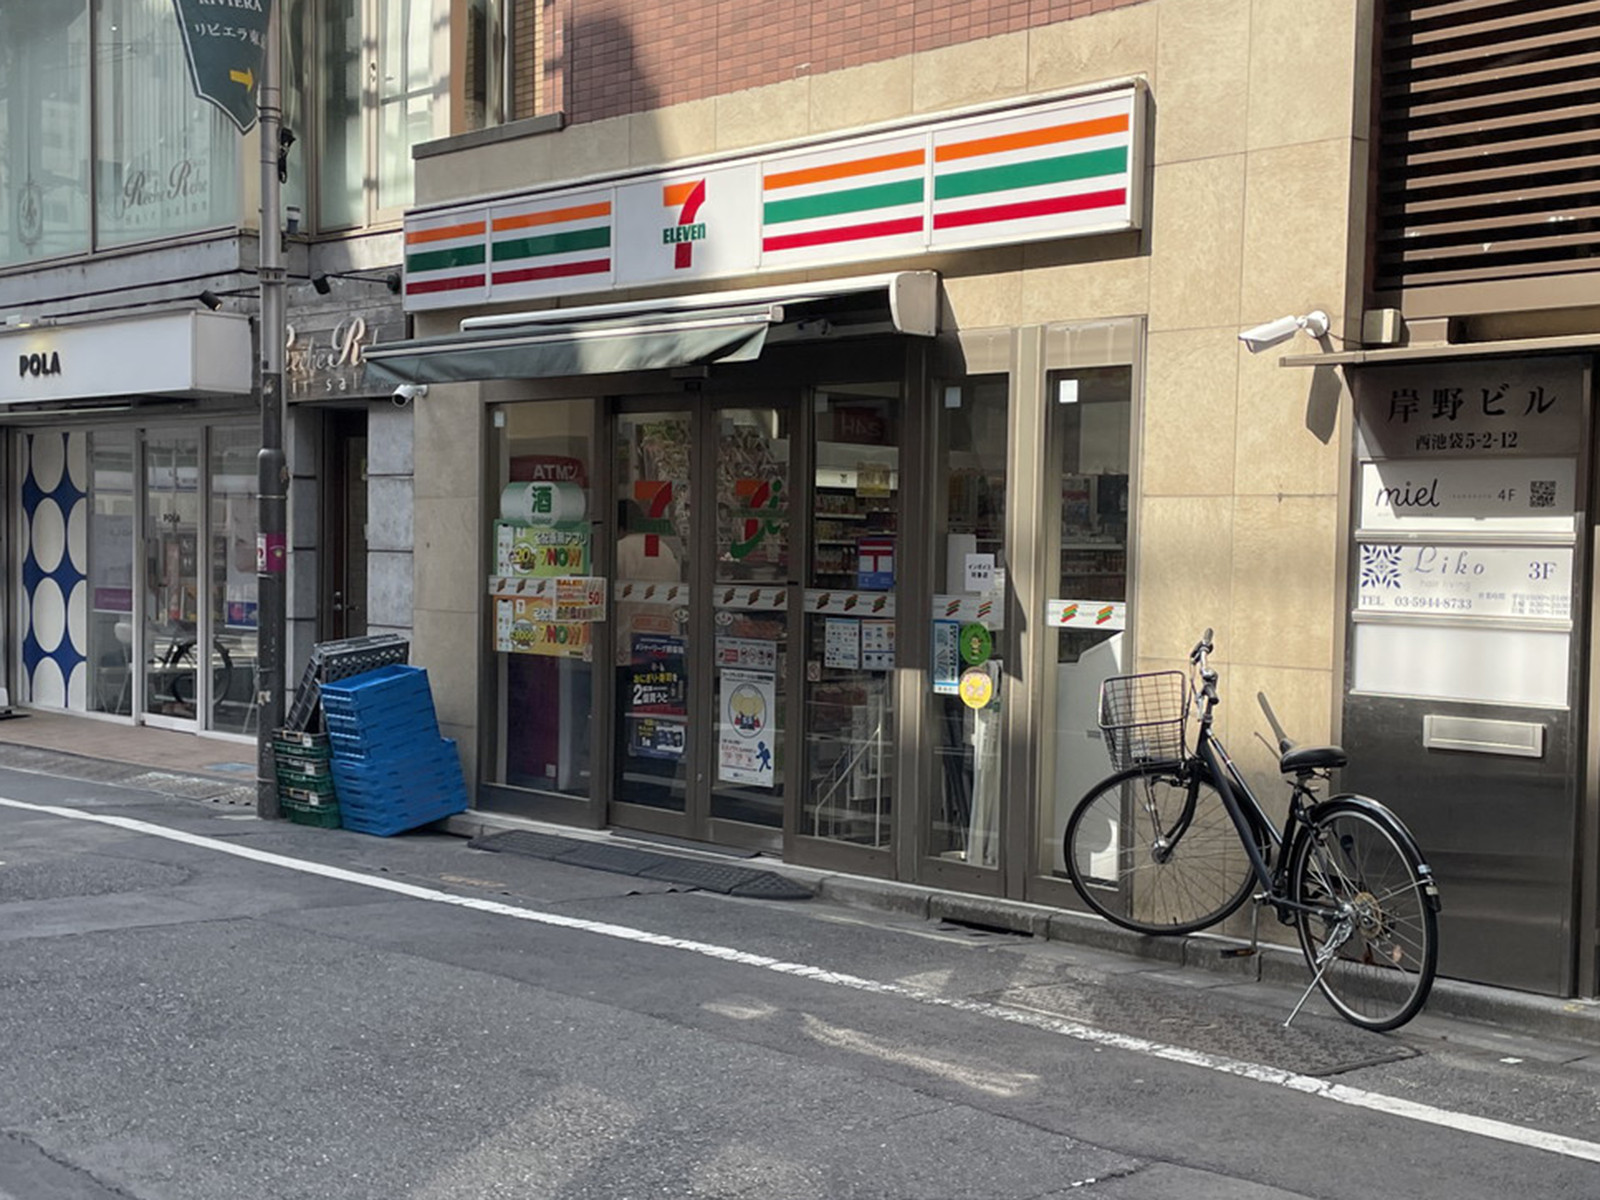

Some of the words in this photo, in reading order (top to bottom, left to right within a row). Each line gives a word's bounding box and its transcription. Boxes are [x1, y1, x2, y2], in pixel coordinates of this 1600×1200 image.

[663, 178, 706, 269] 7
[19, 351, 62, 378] POLA
[1388, 383, 1557, 424] 岸野ビル
[1415, 431, 1518, 450] 西池袋5-2-12
[531, 486, 553, 514] 酒
[1375, 478, 1441, 508] miel
[1497, 488, 1517, 502] 4F
[1413, 545, 1486, 576] Liko
[1528, 561, 1557, 580] 3F
